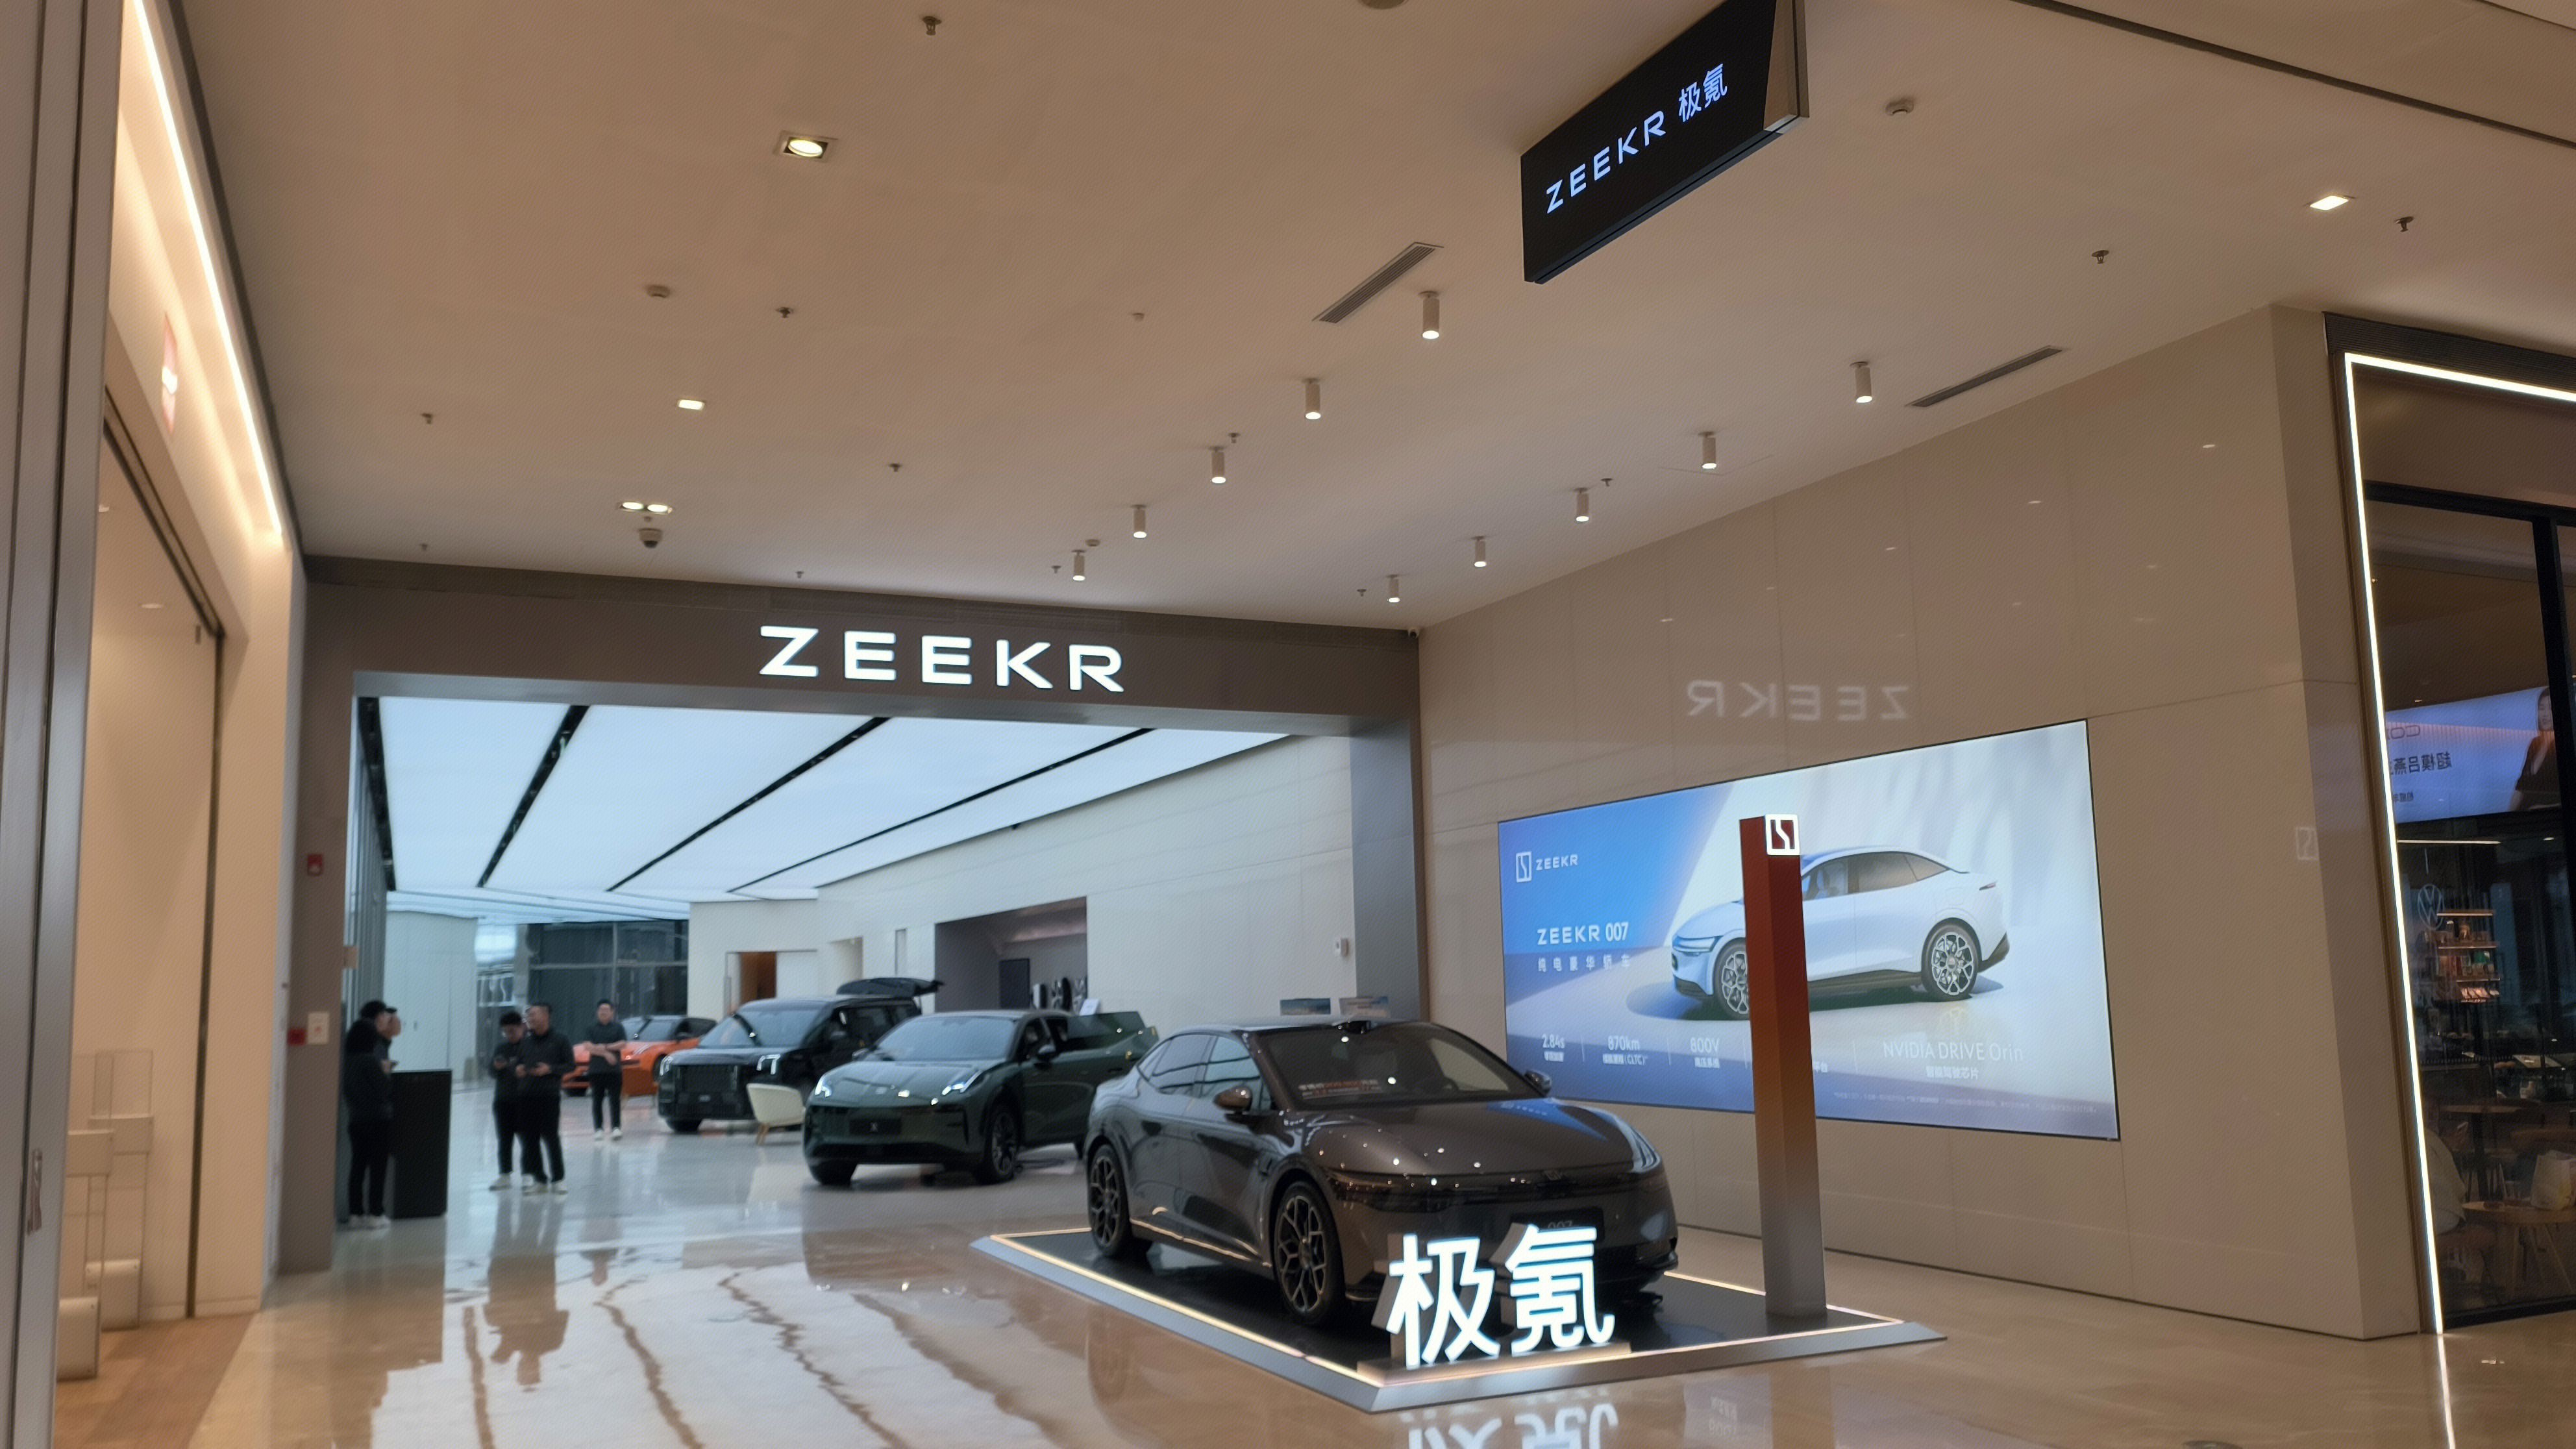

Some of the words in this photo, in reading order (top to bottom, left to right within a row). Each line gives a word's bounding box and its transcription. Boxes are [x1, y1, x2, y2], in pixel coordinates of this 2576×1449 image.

[1546, 110, 1666, 214] ZEEKR
[1678, 63, 1728, 123] 极氪
[759, 625, 1124, 693] ZEEKR
[1536, 854, 1578, 871] ZEEKR
[1537, 924, 1601, 945] ZEEKR
[1605, 922, 1629, 942] 007
[1542, 1034, 1565, 1048] 2.84s
[1608, 1035, 1641, 1050] 870km
[1690, 1037, 1720, 1053] 800V
[1883, 1041, 1935, 1059] NVIDIA
[1938, 1041, 1985, 1061] DRIVE
[1989, 1043, 2024, 1062] Orin
[1386, 1224, 1616, 1370] 极氪
